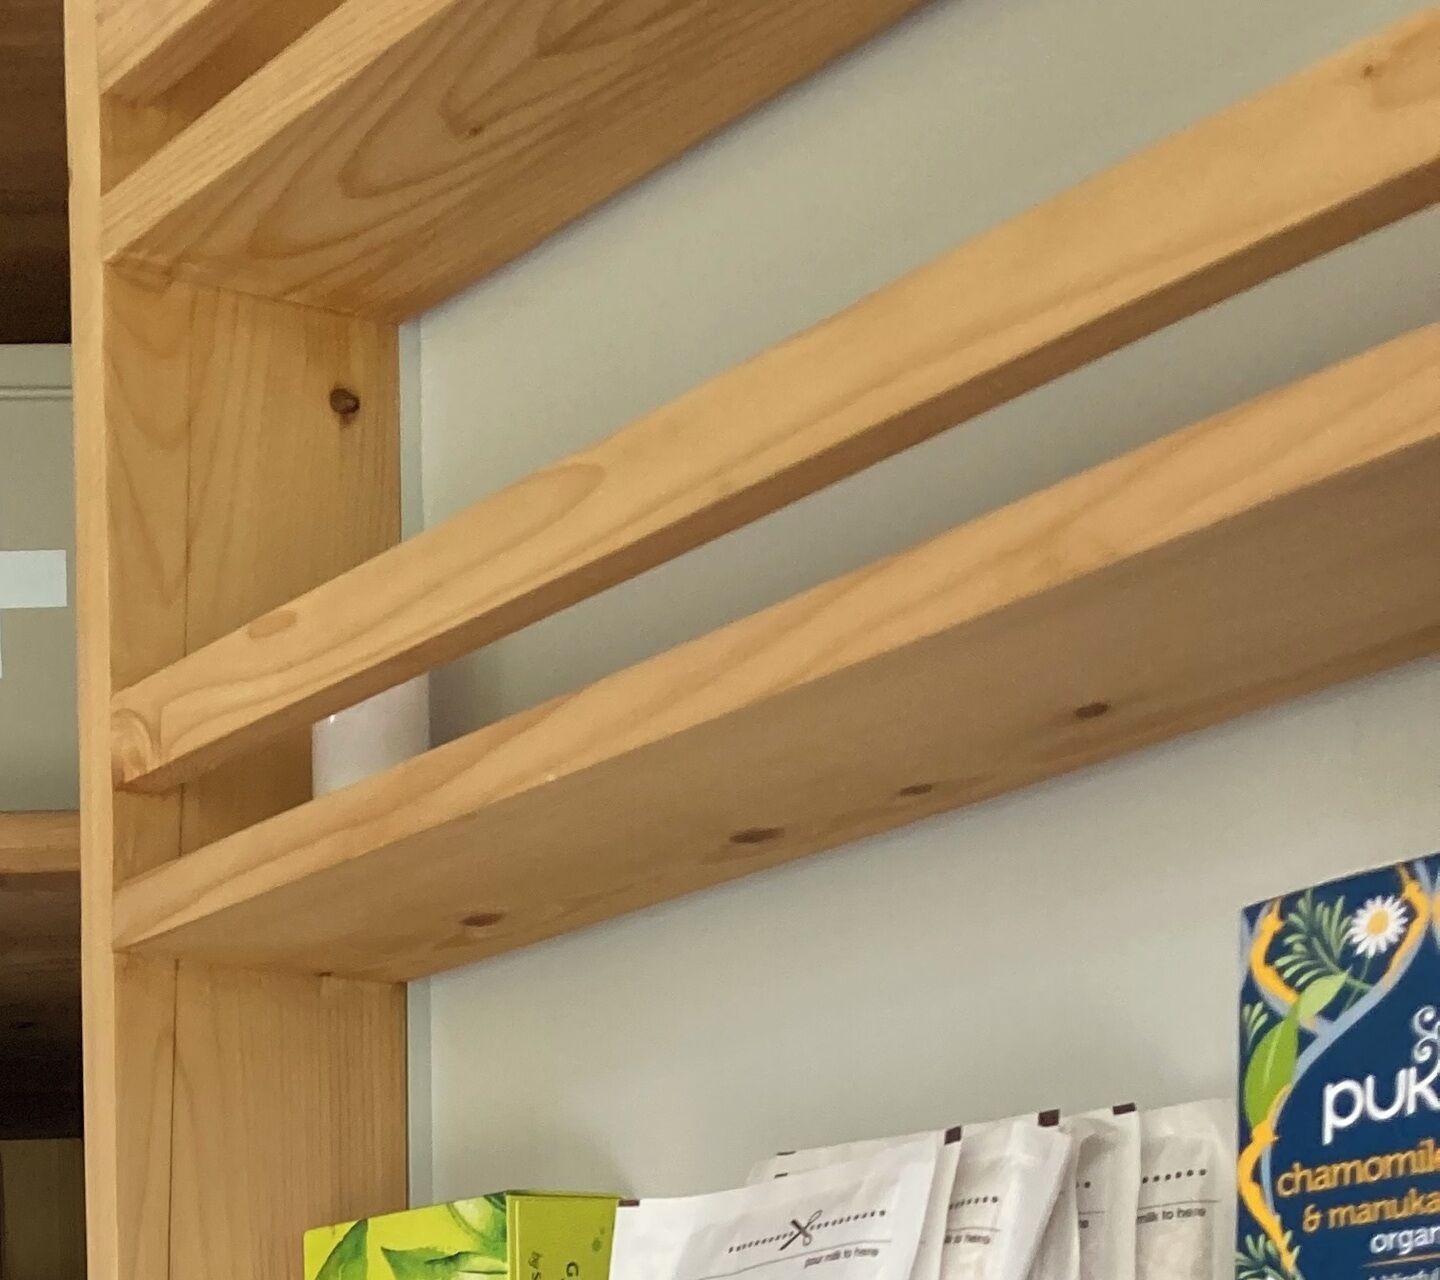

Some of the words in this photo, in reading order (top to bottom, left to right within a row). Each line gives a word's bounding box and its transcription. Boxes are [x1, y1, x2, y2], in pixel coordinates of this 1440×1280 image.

[1162, 1209, 1173, 1220] to
[1302, 1204, 1323, 1233] &
[1328, 1188, 1440, 1229] manuka
